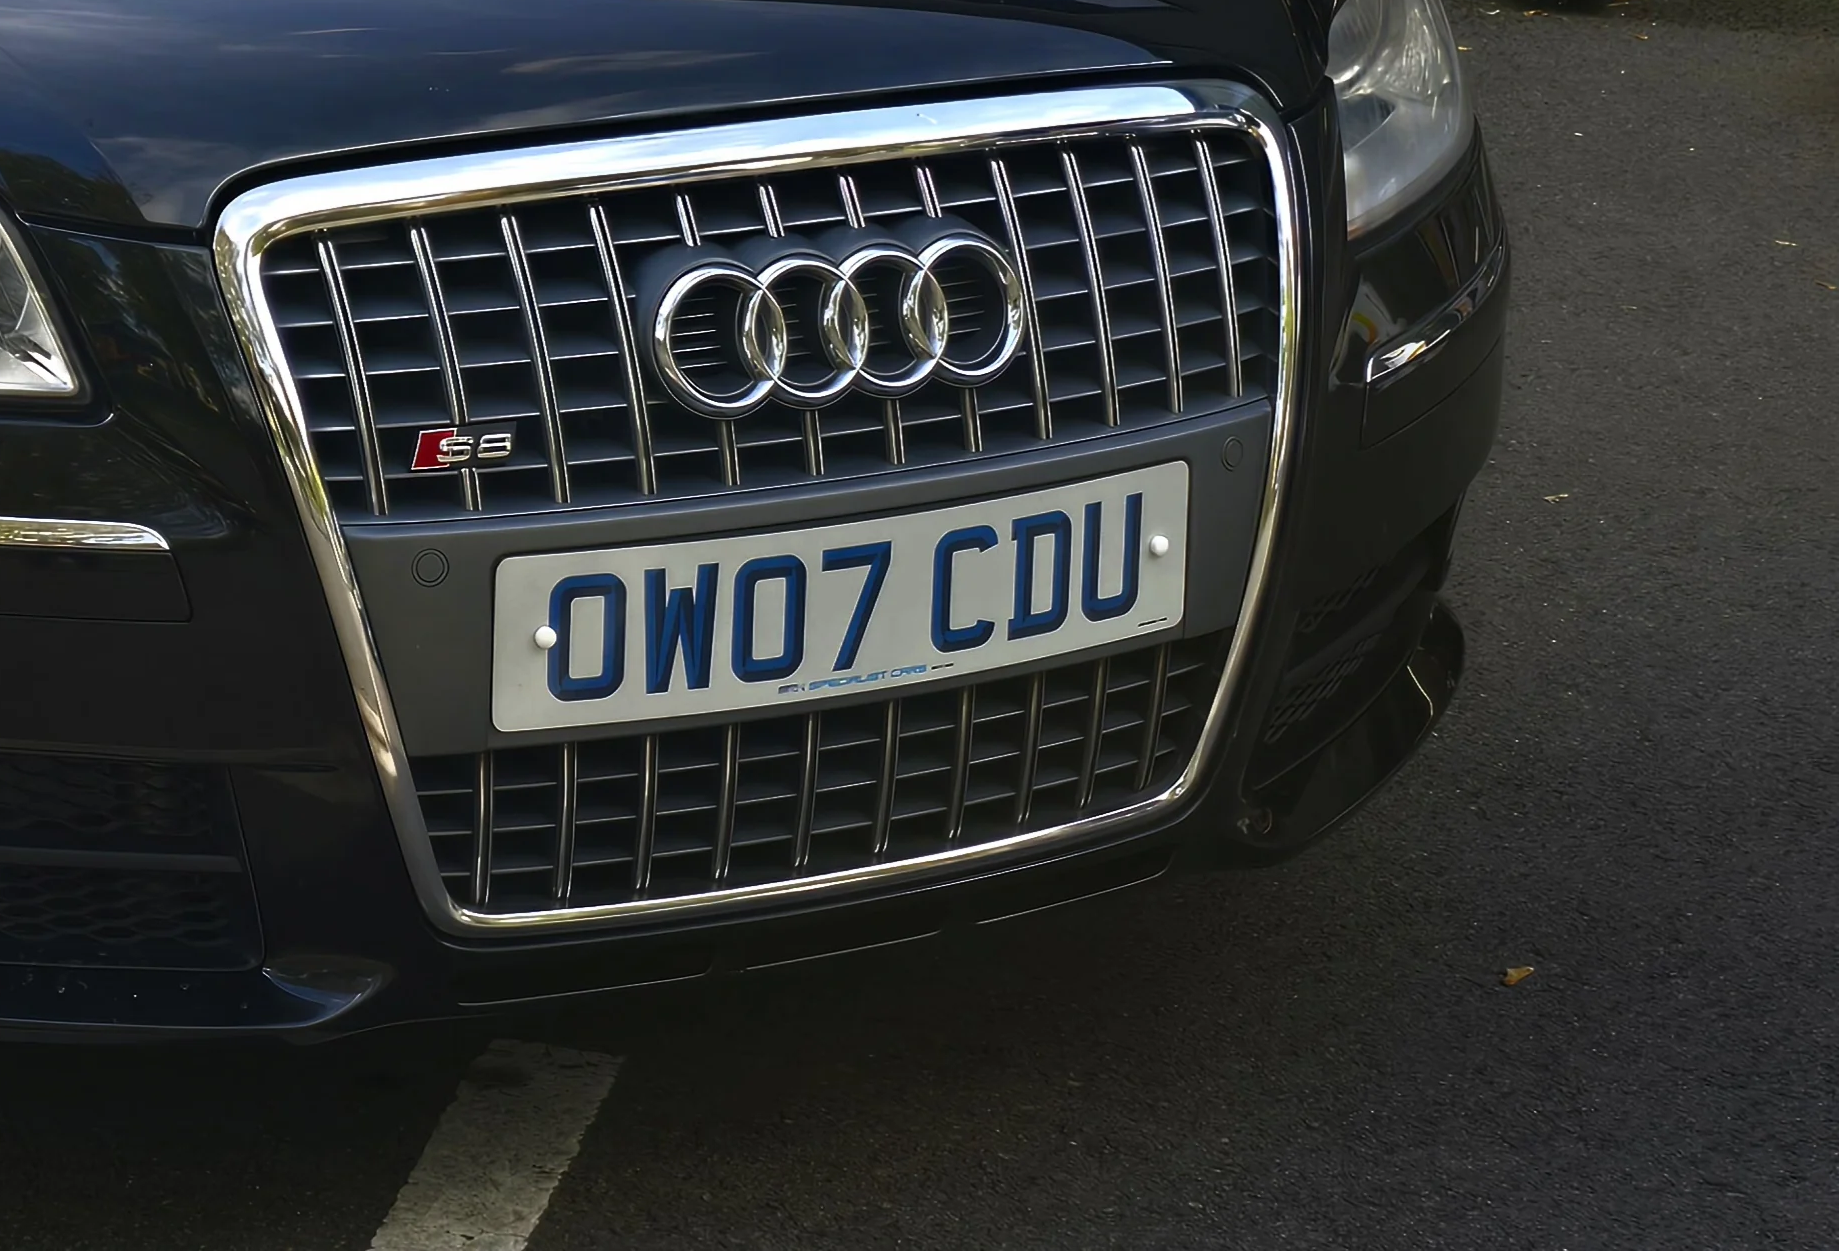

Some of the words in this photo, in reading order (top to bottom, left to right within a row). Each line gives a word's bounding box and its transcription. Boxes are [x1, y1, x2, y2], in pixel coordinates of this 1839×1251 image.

[436, 433, 512, 463] S8
[547, 540, 893, 702] OW07
[930, 492, 1143, 654] CDU
